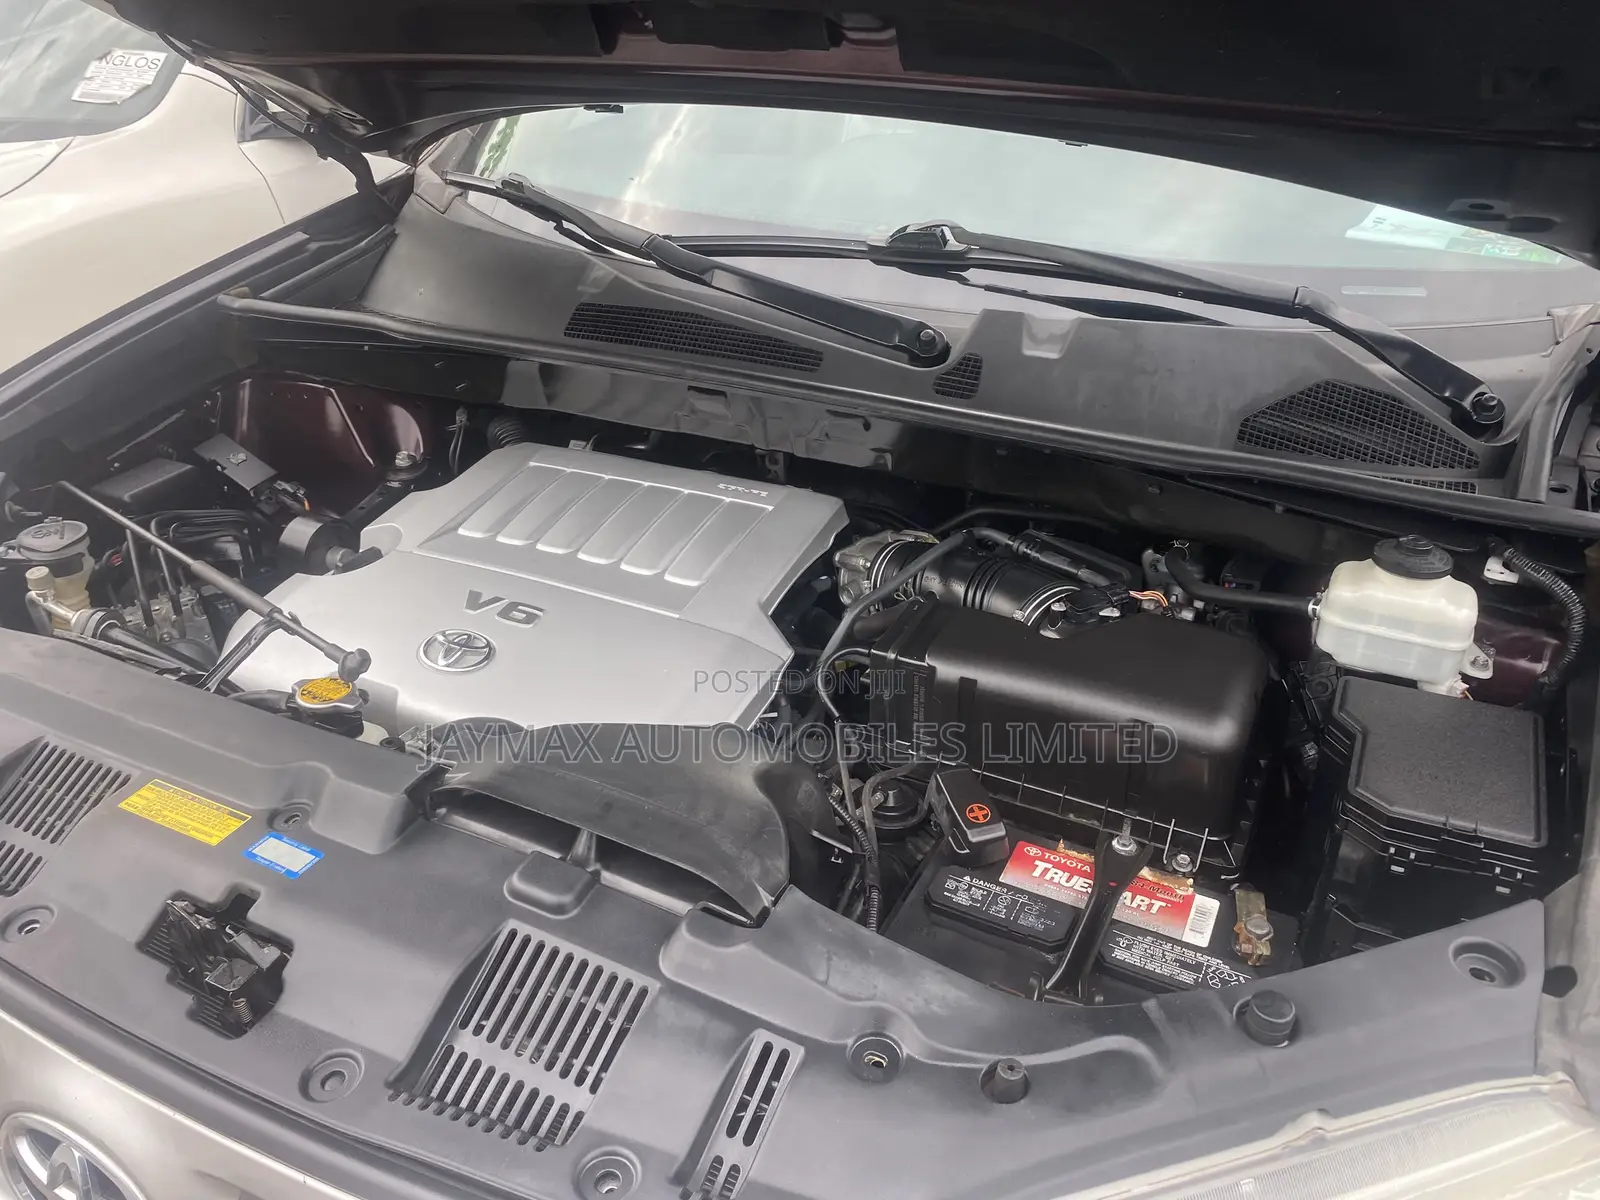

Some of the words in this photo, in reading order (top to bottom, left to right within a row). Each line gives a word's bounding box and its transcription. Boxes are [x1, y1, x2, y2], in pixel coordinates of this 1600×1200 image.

[463, 589, 546, 628] V6
[1044, 852, 1091, 873] TOYOTA
[972, 877, 1008, 894] DANGER
[1163, 950, 1196, 964] IMMEDIATELY
